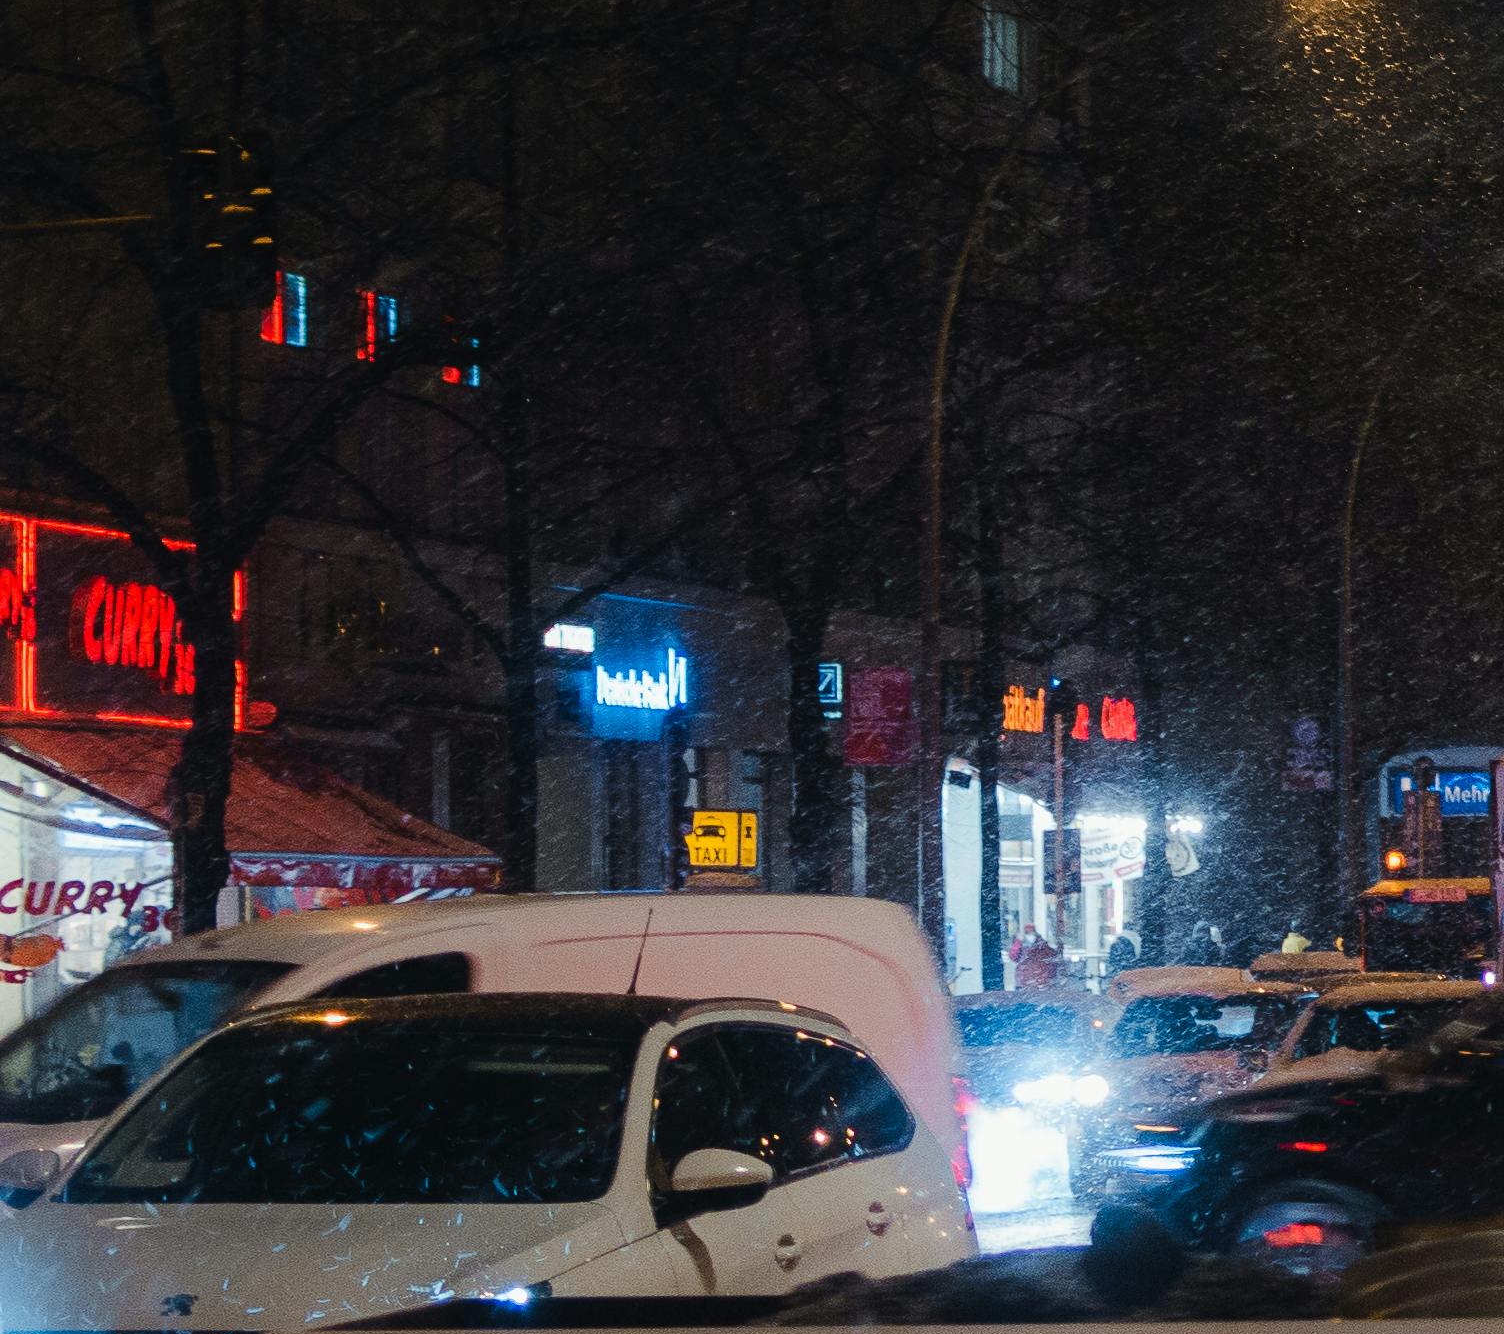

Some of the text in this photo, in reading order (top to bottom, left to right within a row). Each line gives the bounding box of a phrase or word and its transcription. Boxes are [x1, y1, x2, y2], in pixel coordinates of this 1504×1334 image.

[83, 575, 175, 679] CURRY
[695, 847, 727, 864] TAXI
[0, 877, 145, 917] CURRY
